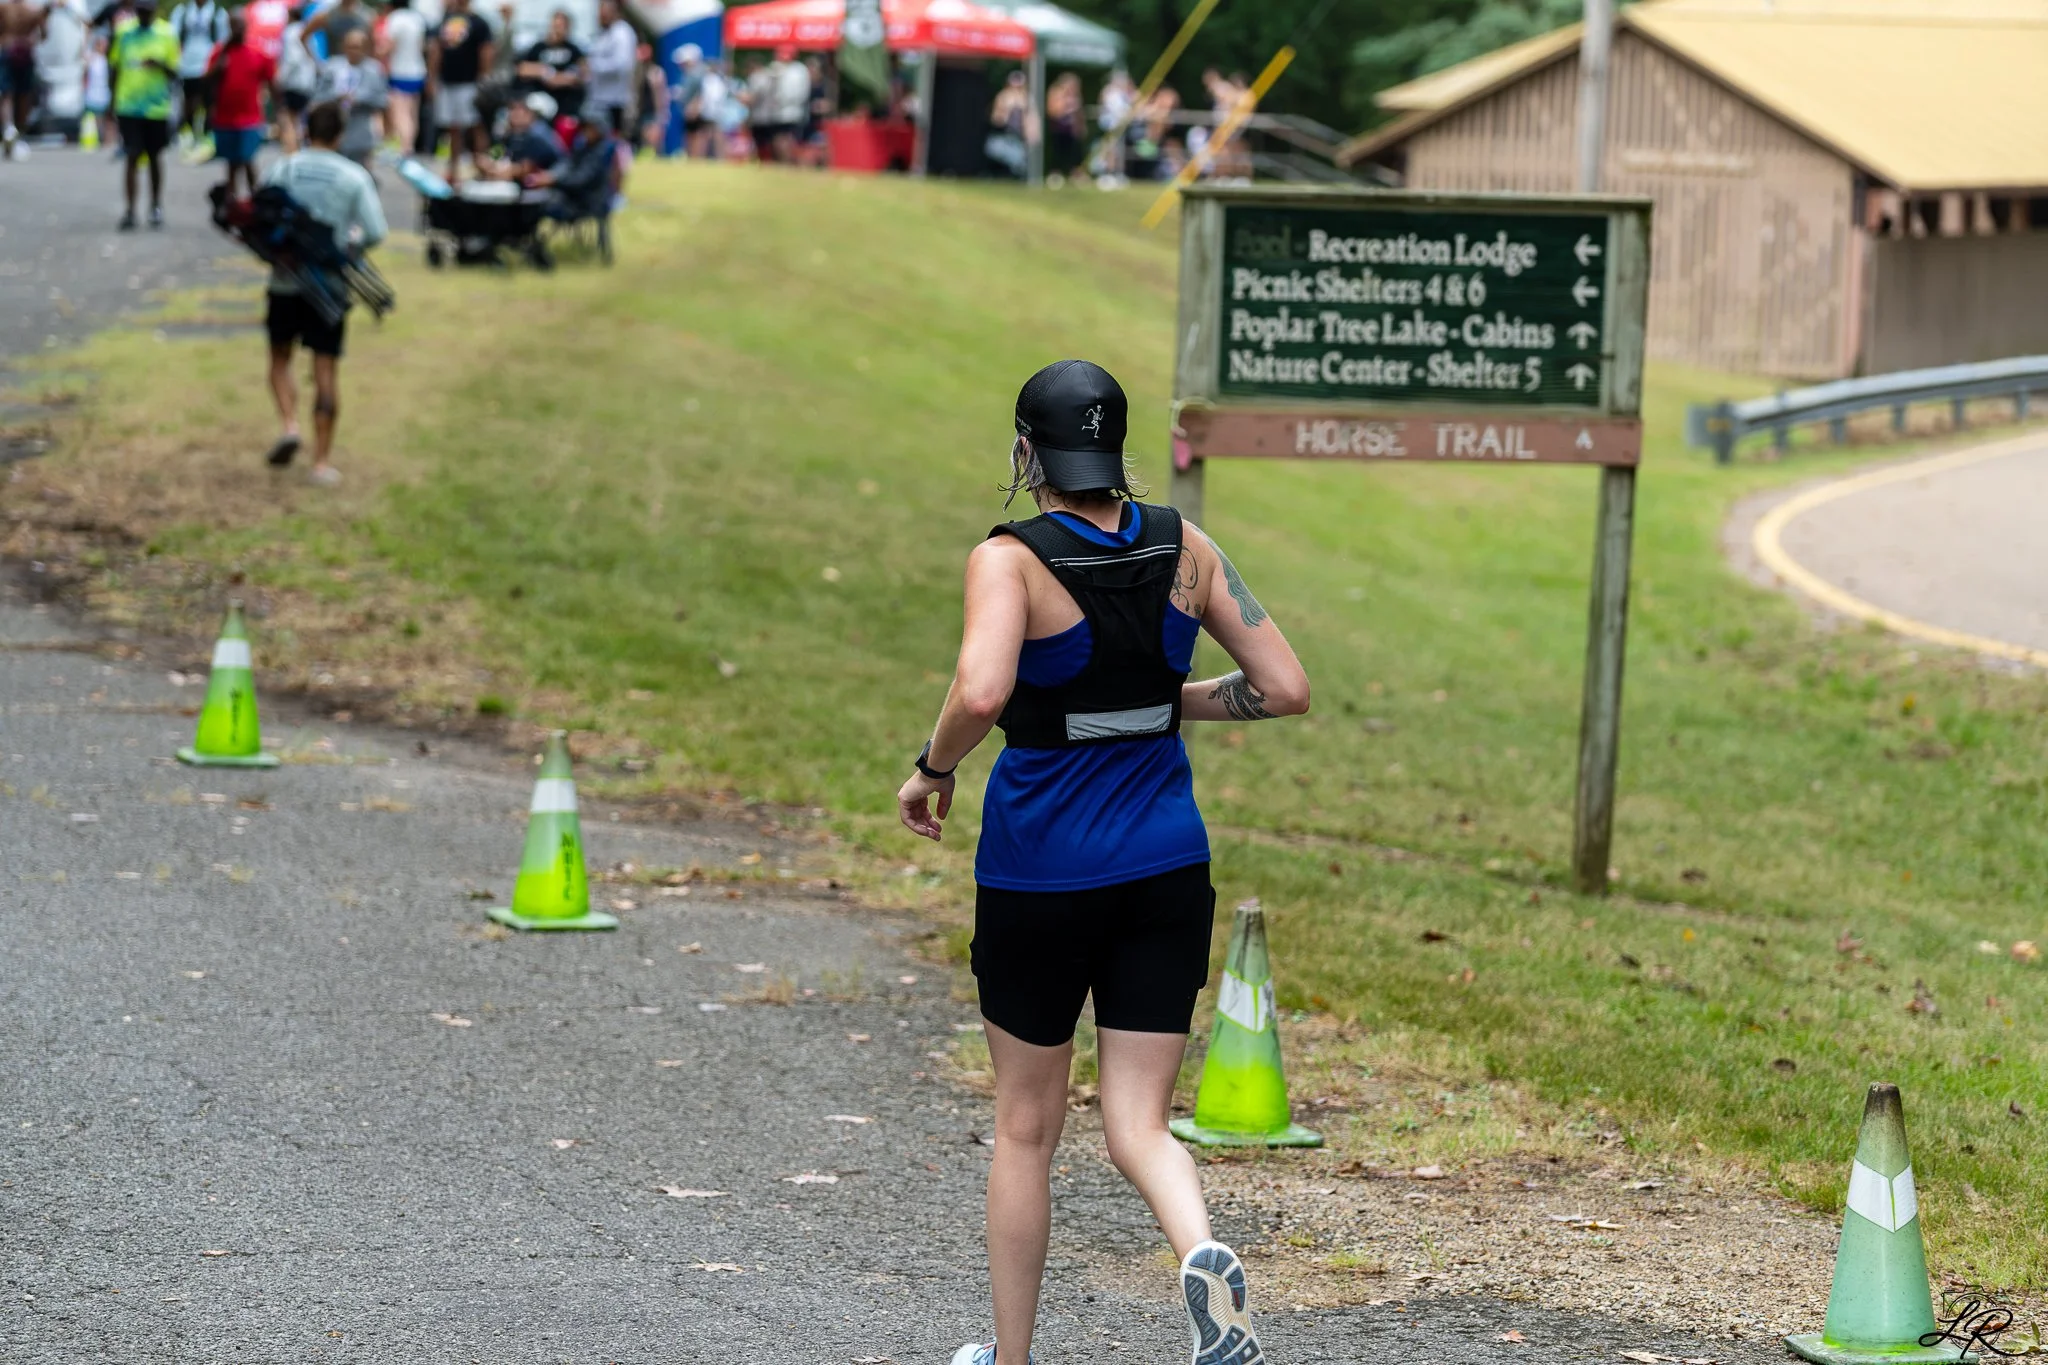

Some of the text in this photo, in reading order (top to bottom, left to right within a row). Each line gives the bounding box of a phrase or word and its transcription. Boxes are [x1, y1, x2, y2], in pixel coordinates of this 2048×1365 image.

[1308, 229, 1451, 264] Recreation
[1453, 230, 1538, 277] Lodge
[1232, 267, 1314, 301] Picnic
[1315, 266, 1423, 305] Shelters
[1231, 306, 1317, 350] Poplar
[1319, 310, 1380, 345] Tree
[1382, 309, 1448, 347] Lake
[1462, 311, 1555, 348] Cabins
[1229, 350, 1320, 384] Nature
[1321, 351, 1412, 386] Center
[1427, 350, 1522, 389] Shelter
[1523, 356, 1543, 394] 5
[1295, 421, 1537, 459] HORSE TRAIL
